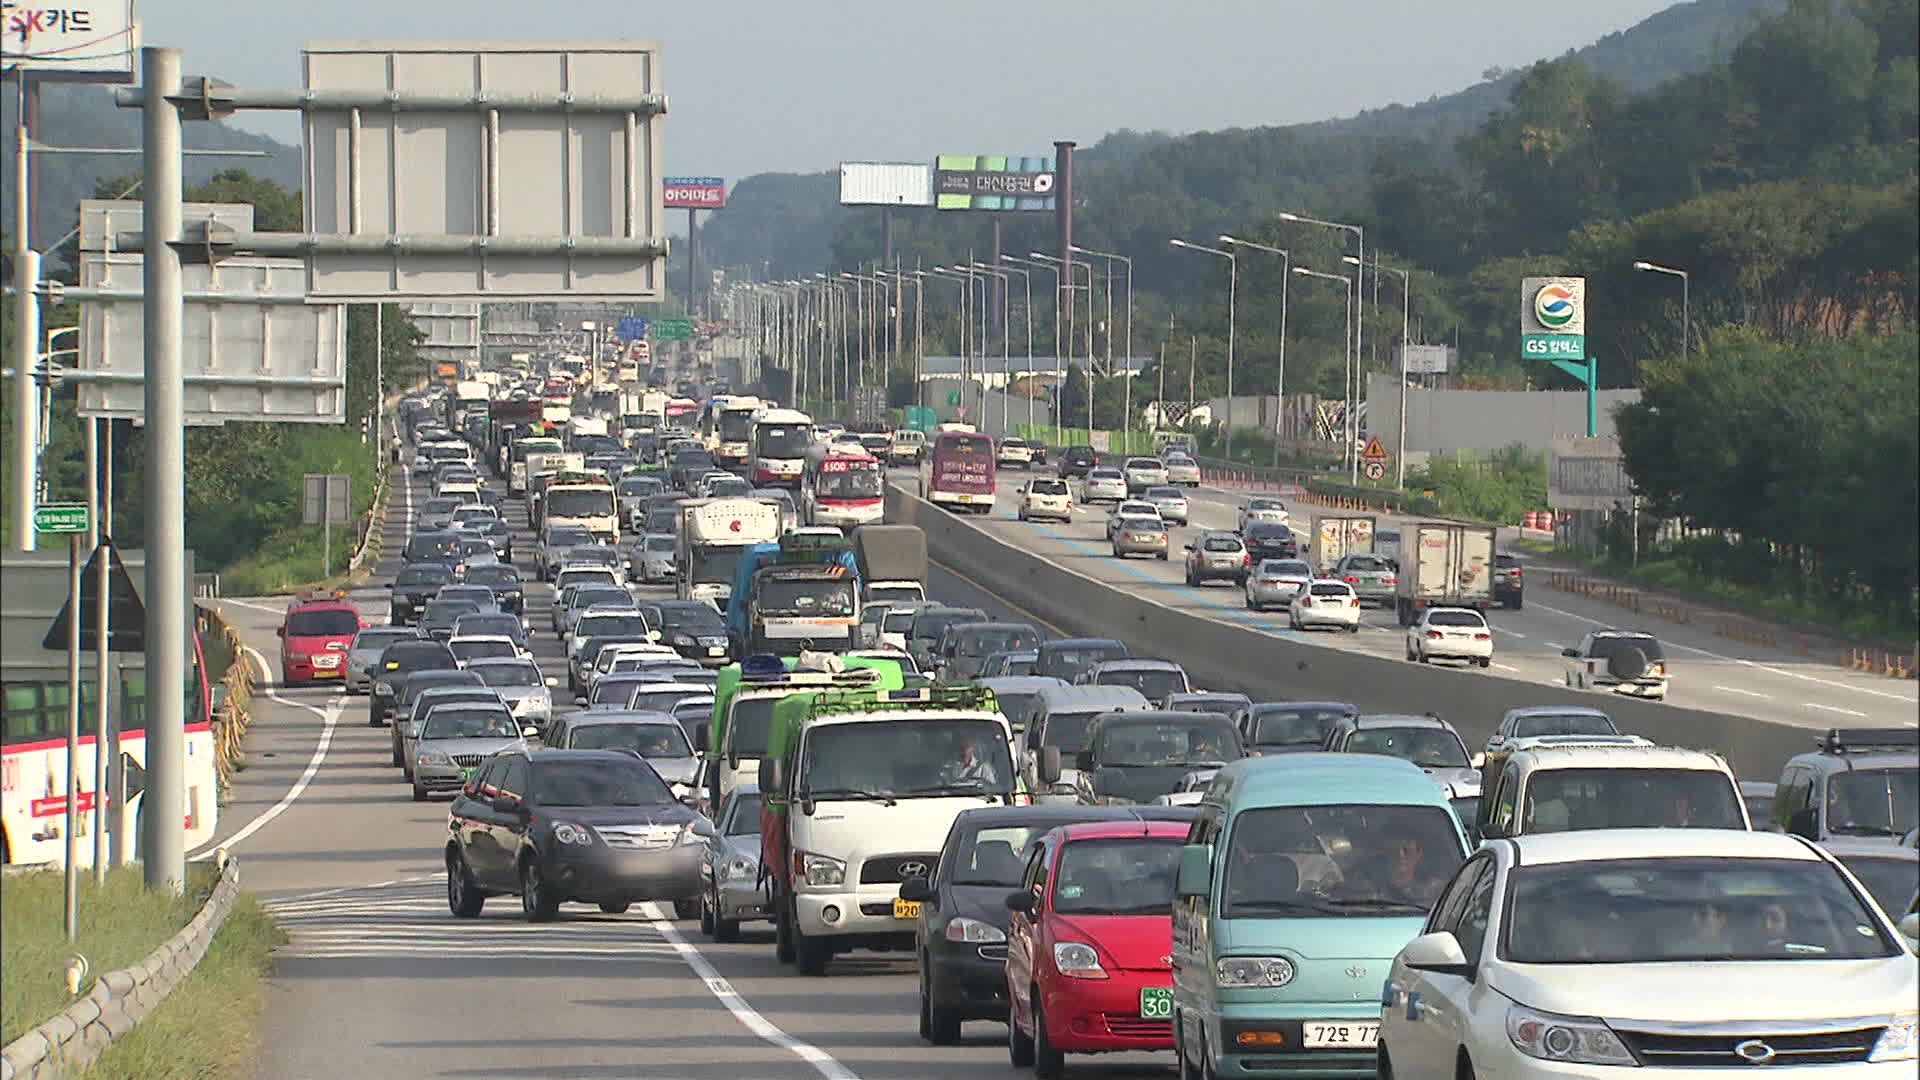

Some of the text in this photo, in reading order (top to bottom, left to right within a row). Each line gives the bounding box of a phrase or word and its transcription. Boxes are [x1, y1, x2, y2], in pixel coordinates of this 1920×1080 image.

[976, 175, 1030, 192] 대신증권
[1526, 339, 1548, 353] GS
[1145, 998, 1170, 1016] 30
[1314, 1026, 1380, 1042] 72모 77
